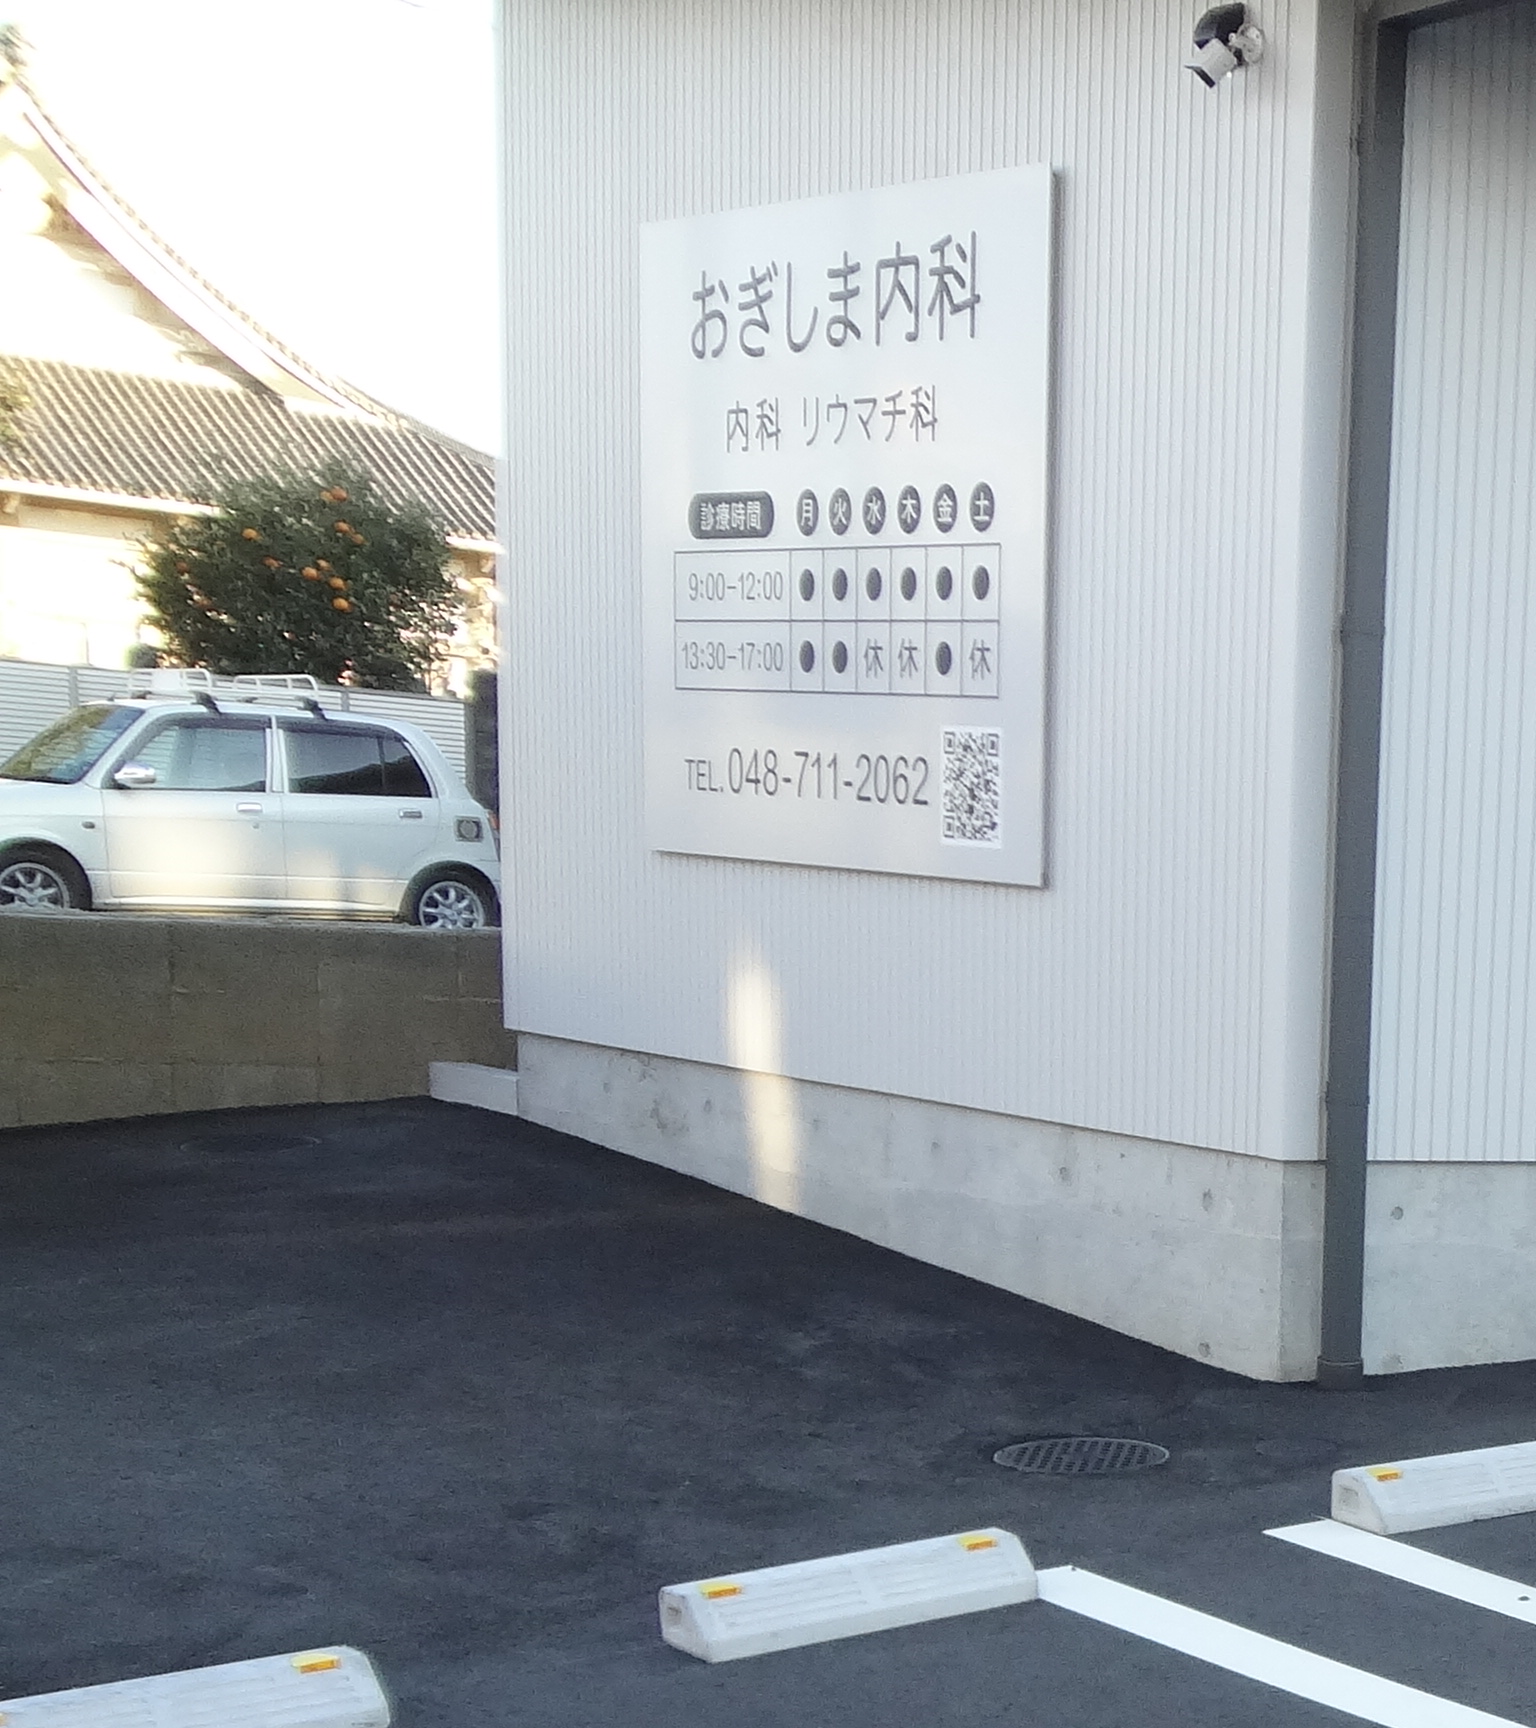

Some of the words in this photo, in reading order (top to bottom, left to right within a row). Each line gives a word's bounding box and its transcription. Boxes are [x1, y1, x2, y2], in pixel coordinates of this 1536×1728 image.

[691, 231, 981, 359] おぎしま内科
[726, 397, 781, 453] 内科
[802, 385, 938, 446] リウマチ科
[700, 501, 762, 531] 診療時間
[801, 499, 814, 527] 月
[833, 498, 848, 526] 火
[866, 495, 882, 525] 水
[901, 494, 918, 524] 木
[937, 493, 954, 523] 金
[973, 491, 990, 521] 土
[863, 638, 884, 678] 休
[897, 638, 918, 679] 休
[969, 638, 991, 680] 休
[684, 759, 724, 793] TEL.
[728, 748, 929, 806] 048-711-2062
